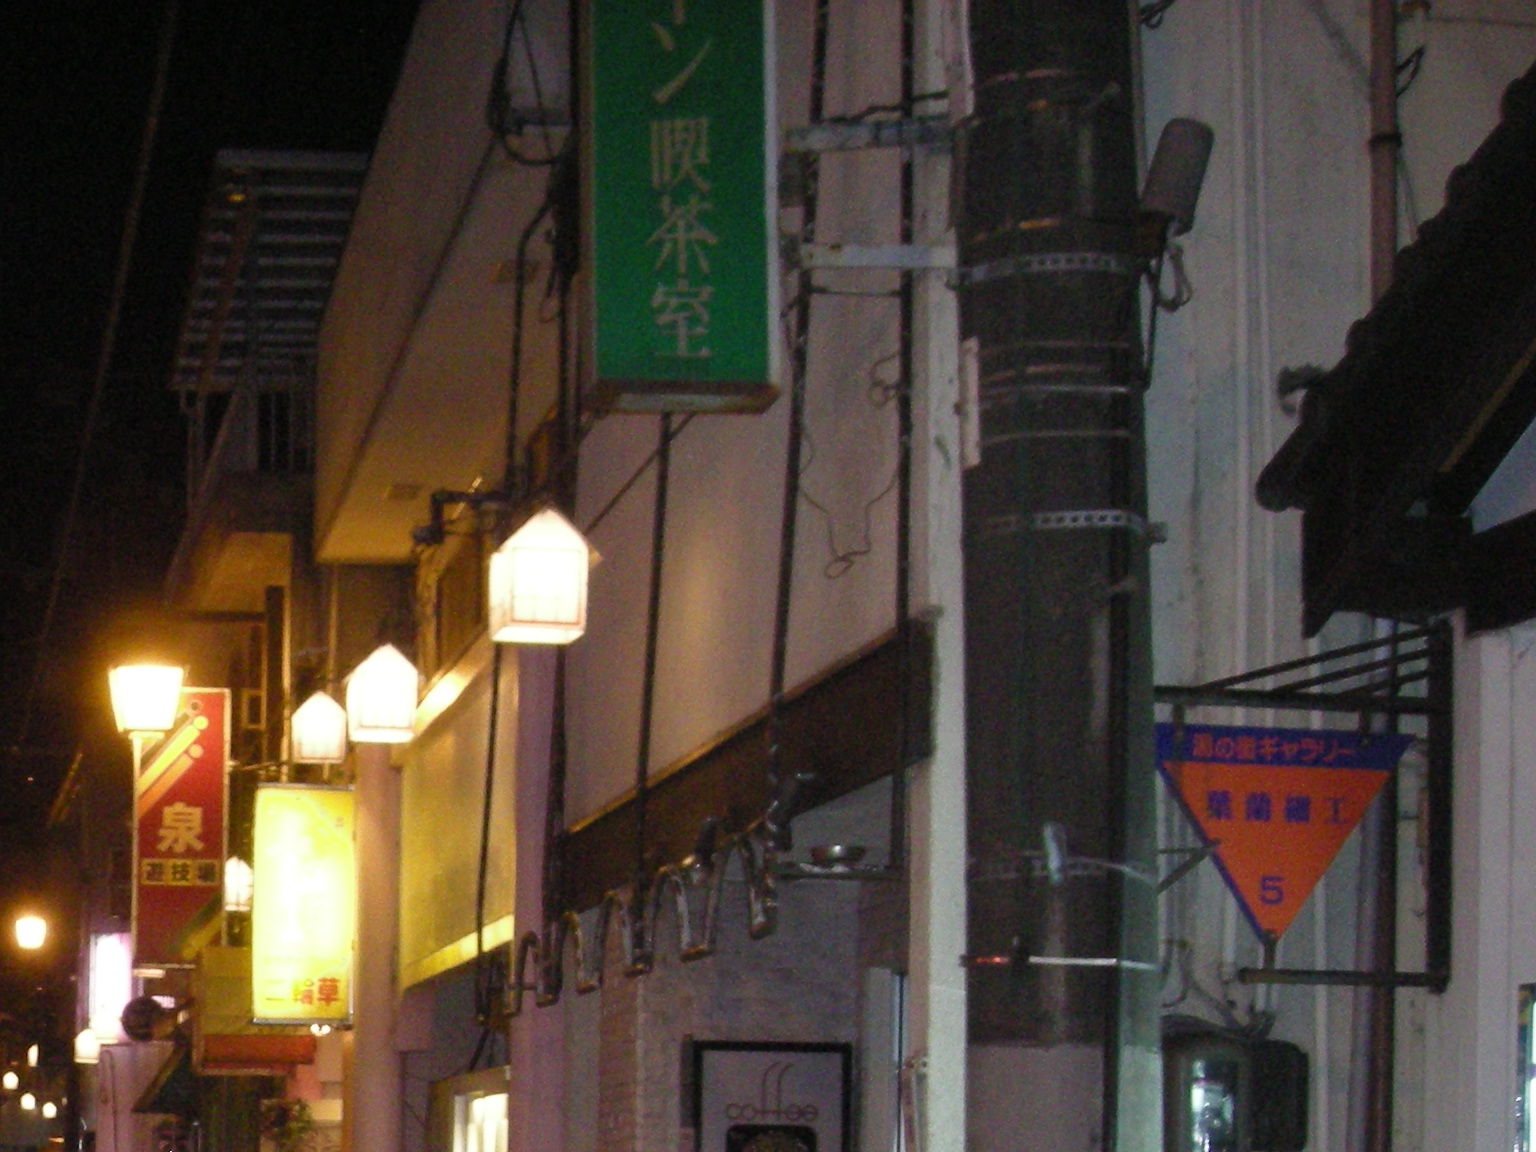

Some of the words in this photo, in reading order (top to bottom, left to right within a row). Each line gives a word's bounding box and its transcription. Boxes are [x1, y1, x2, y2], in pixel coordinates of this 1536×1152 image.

[646, 0, 717, 357] ン喫茶室
[156, 802, 205, 853] 泉
[1258, 875, 1284, 904] 5
